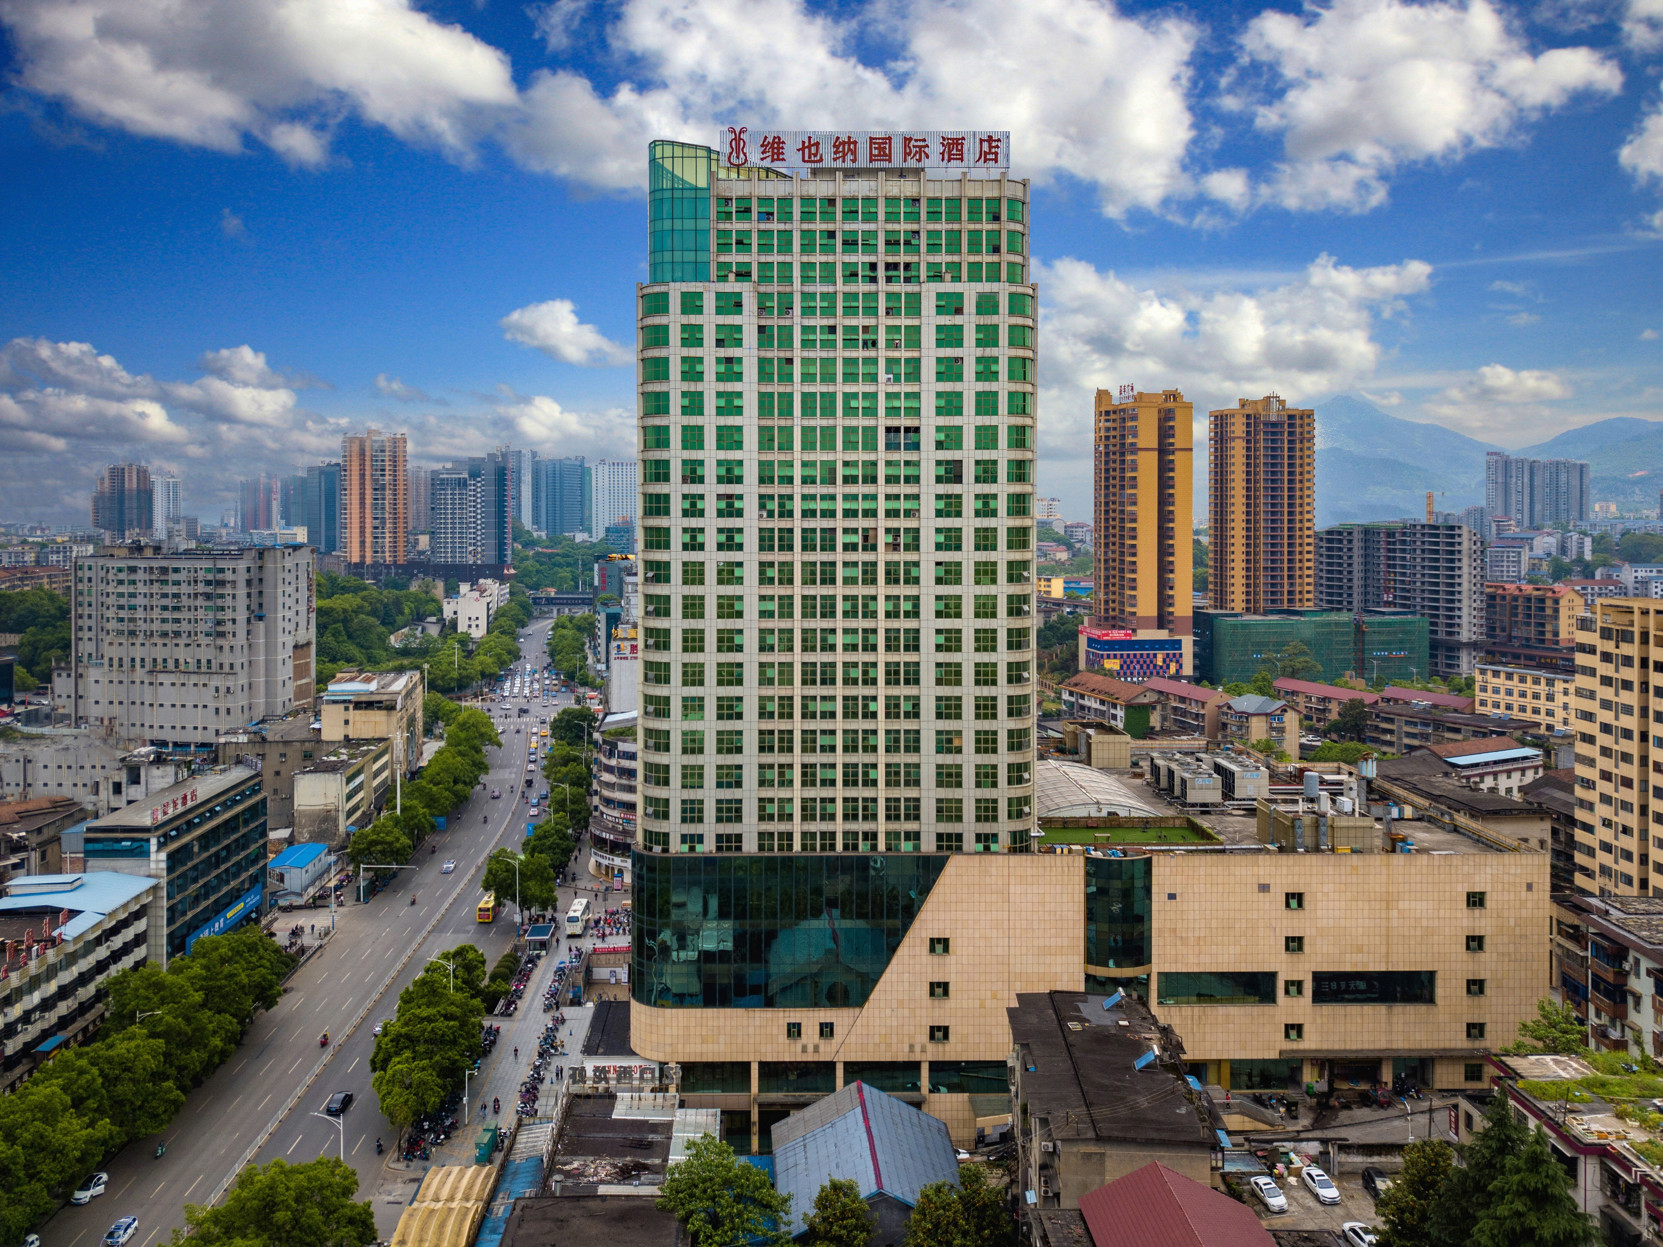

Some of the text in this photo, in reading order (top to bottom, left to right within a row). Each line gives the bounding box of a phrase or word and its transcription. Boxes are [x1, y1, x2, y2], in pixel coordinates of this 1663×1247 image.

[760, 135, 1002, 163] 维也纳国际酒店
